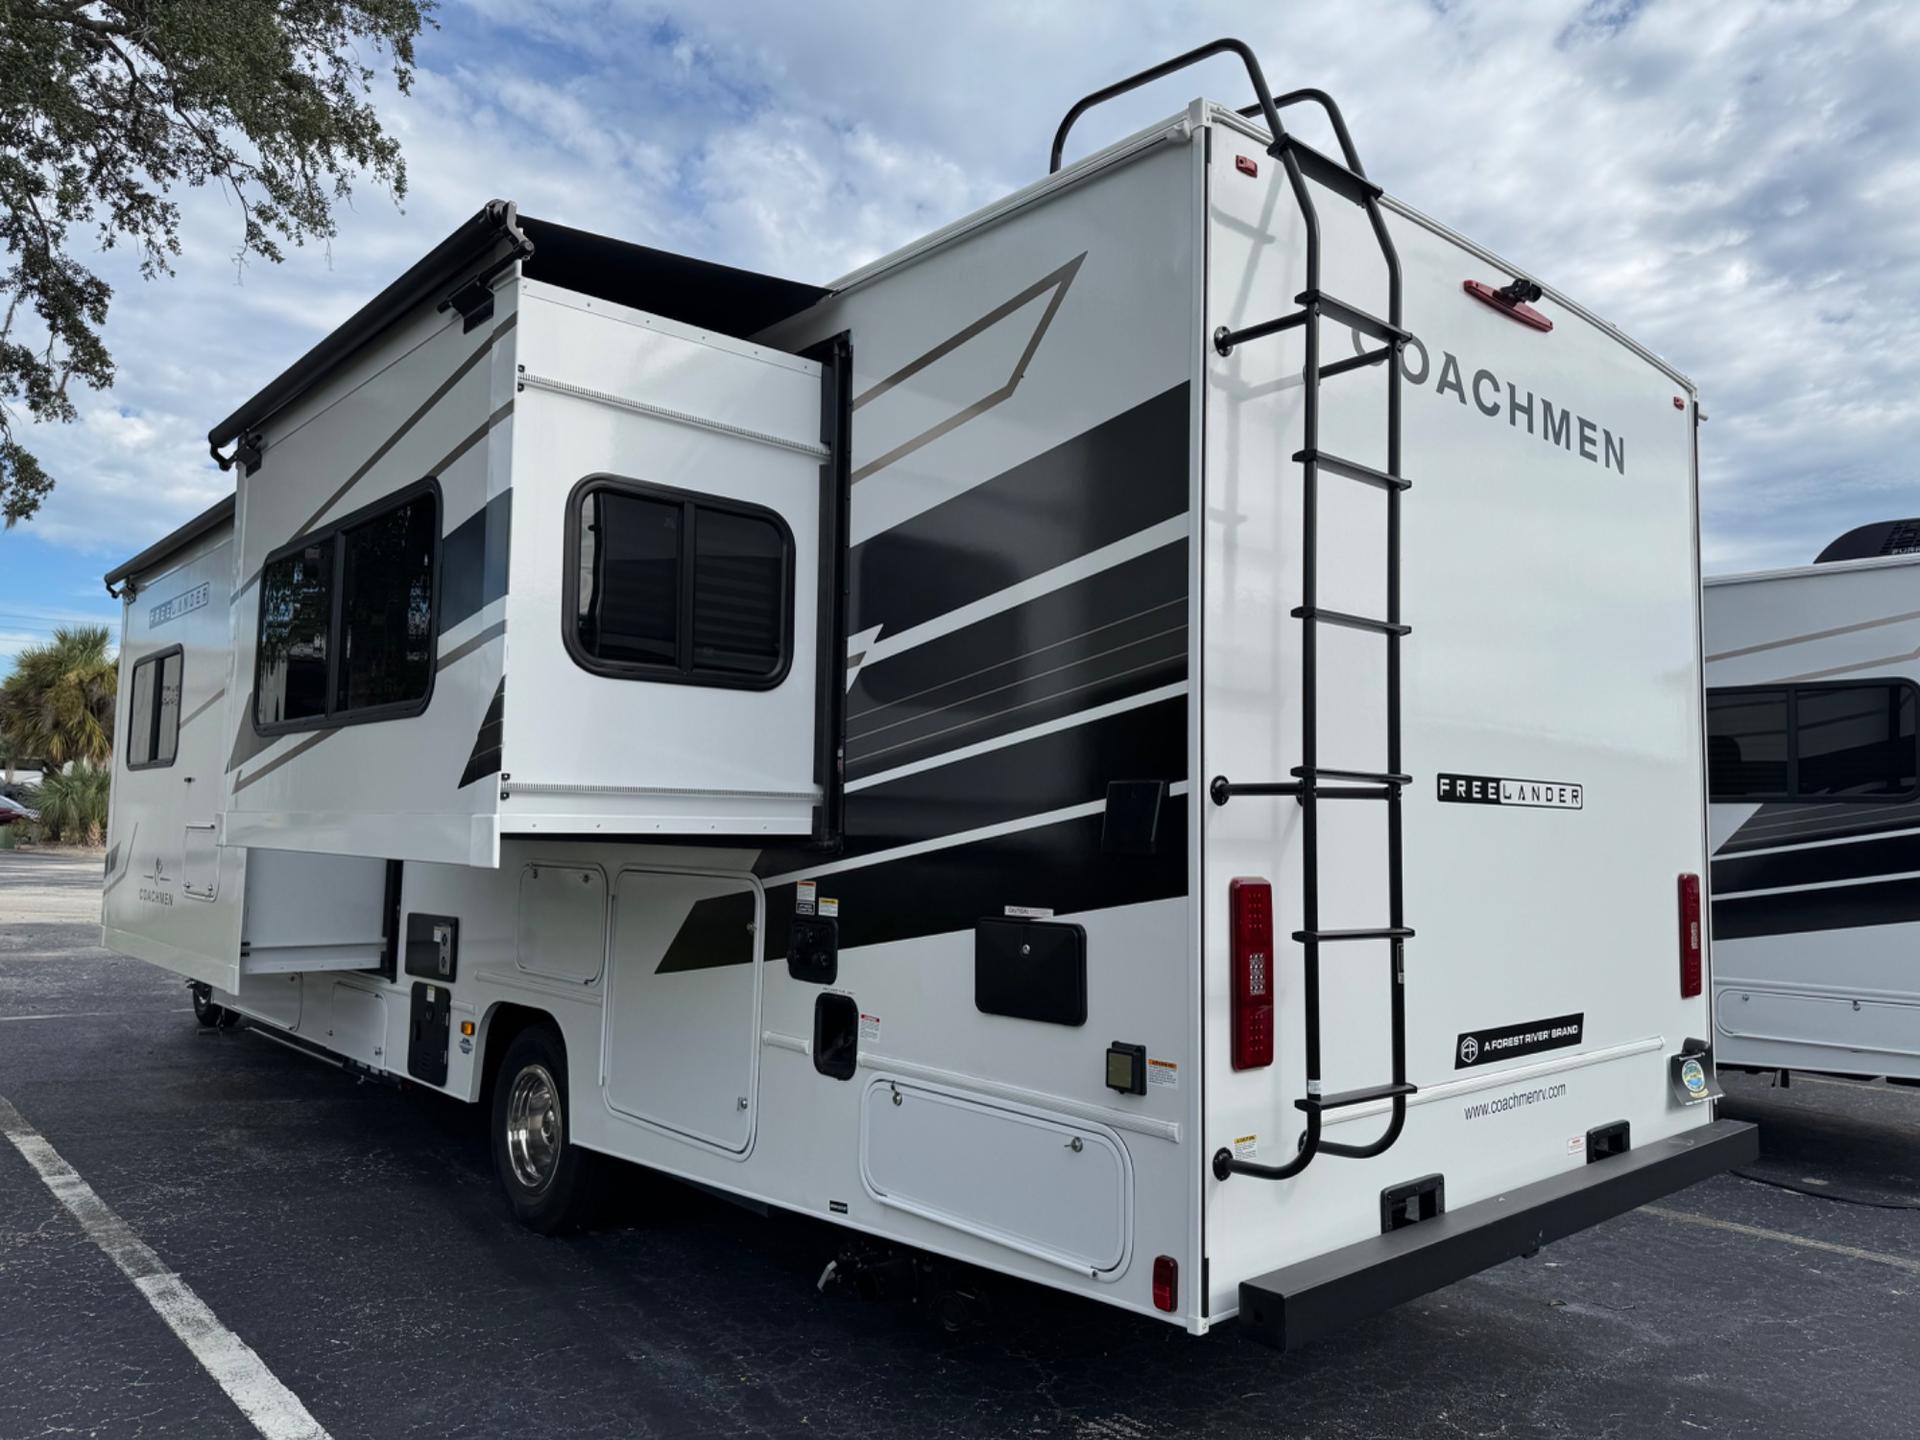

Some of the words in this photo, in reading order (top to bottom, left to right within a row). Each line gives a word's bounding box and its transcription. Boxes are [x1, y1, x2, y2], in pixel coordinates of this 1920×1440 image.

[1439, 778, 1580, 804] FREELANDER
[1484, 1041, 1491, 1052] A
[1491, 1034, 1524, 1050] FOREST
[1551, 1025, 1579, 1039] BRAND
[1464, 1083, 1566, 1120] www.coachmenrv.com
